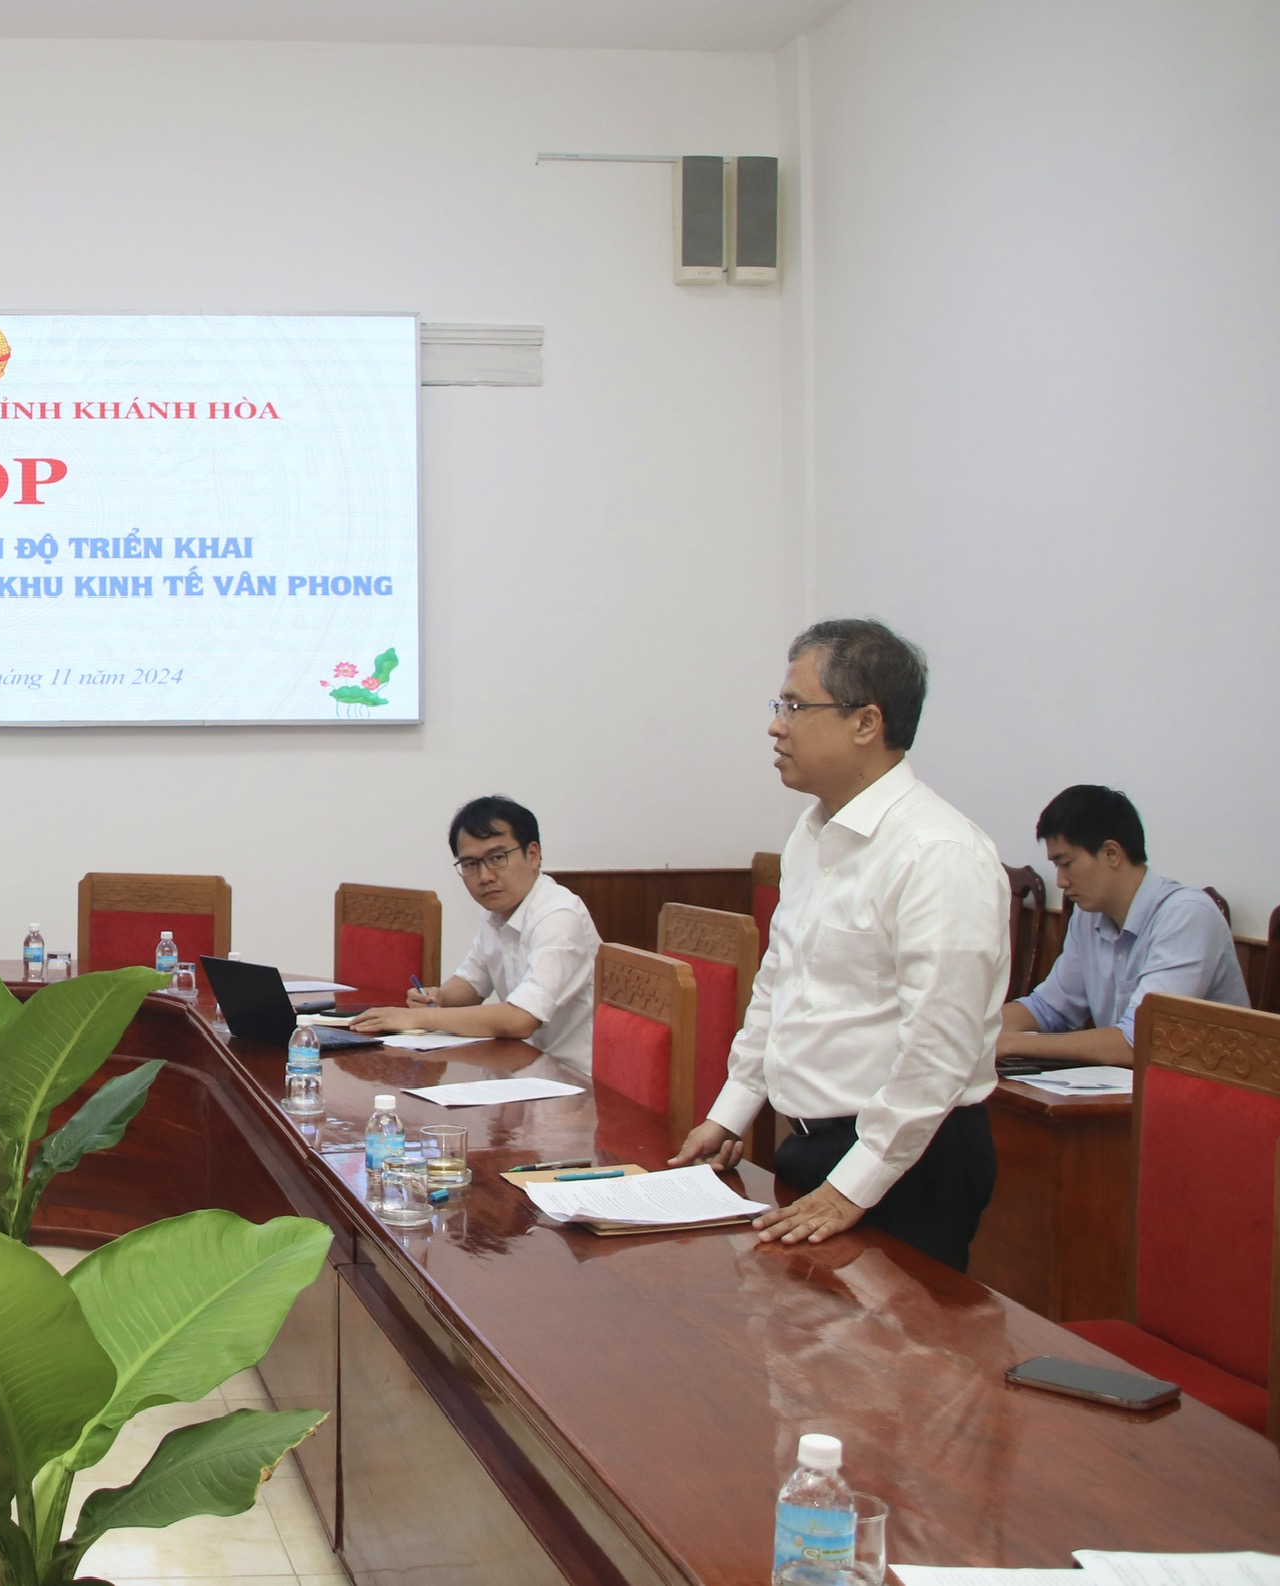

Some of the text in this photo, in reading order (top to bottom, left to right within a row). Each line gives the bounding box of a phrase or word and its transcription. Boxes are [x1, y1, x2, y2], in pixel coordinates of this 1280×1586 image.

[73, 396, 198, 419] KHÁNH
[208, 396, 281, 419] HÒA
[14, 533, 59, 564] ĐỘ
[69, 527, 163, 559] TRIỂN
[174, 537, 253, 558] KHAI
[74, 576, 153, 597] KINH
[163, 566, 204, 597] TẾ
[213, 571, 277, 597] VÂN
[288, 576, 393, 596] PHONG
[51, 669, 72, 686] 11
[78, 670, 125, 685] năm
[131, 668, 184, 685] 2024
